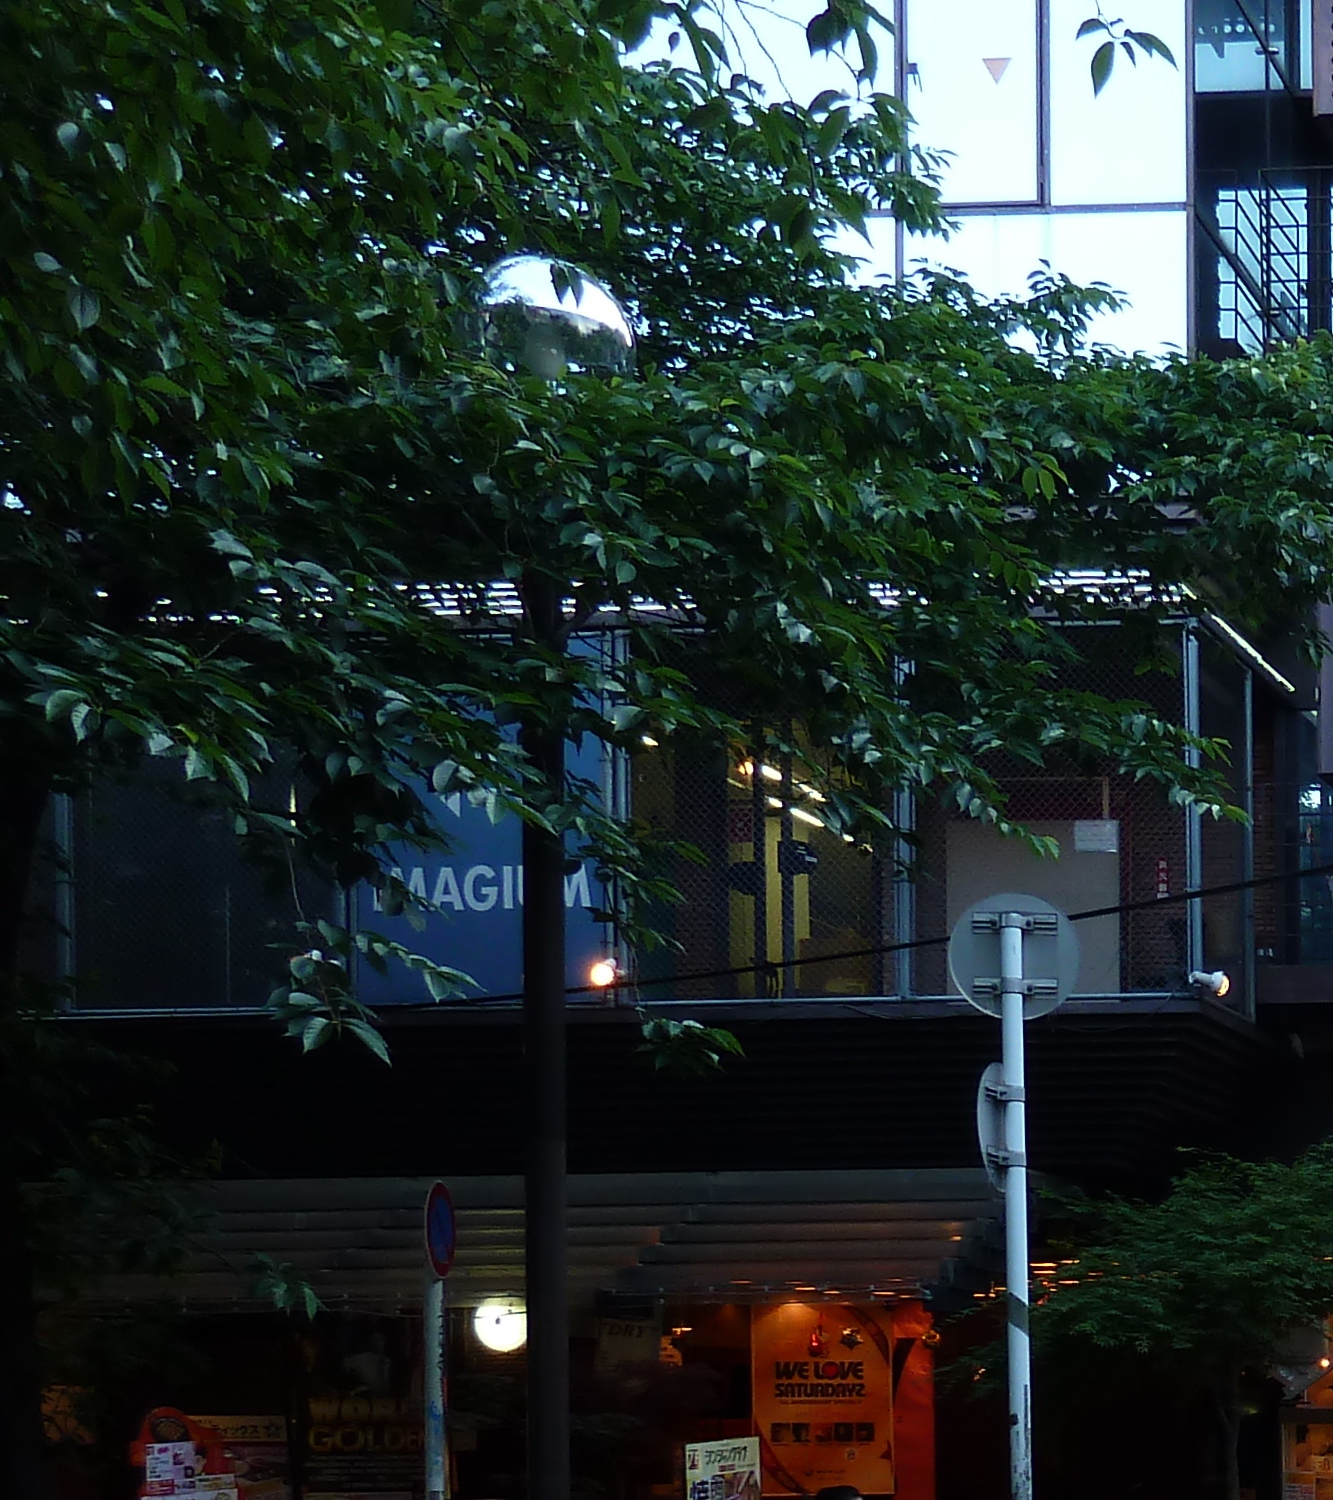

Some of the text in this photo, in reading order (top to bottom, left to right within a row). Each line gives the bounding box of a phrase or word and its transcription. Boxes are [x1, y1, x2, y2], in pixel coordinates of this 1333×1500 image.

[775, 1361, 864, 1380] WE LOVE
[775, 1383, 866, 1398] SATURDAYZ
